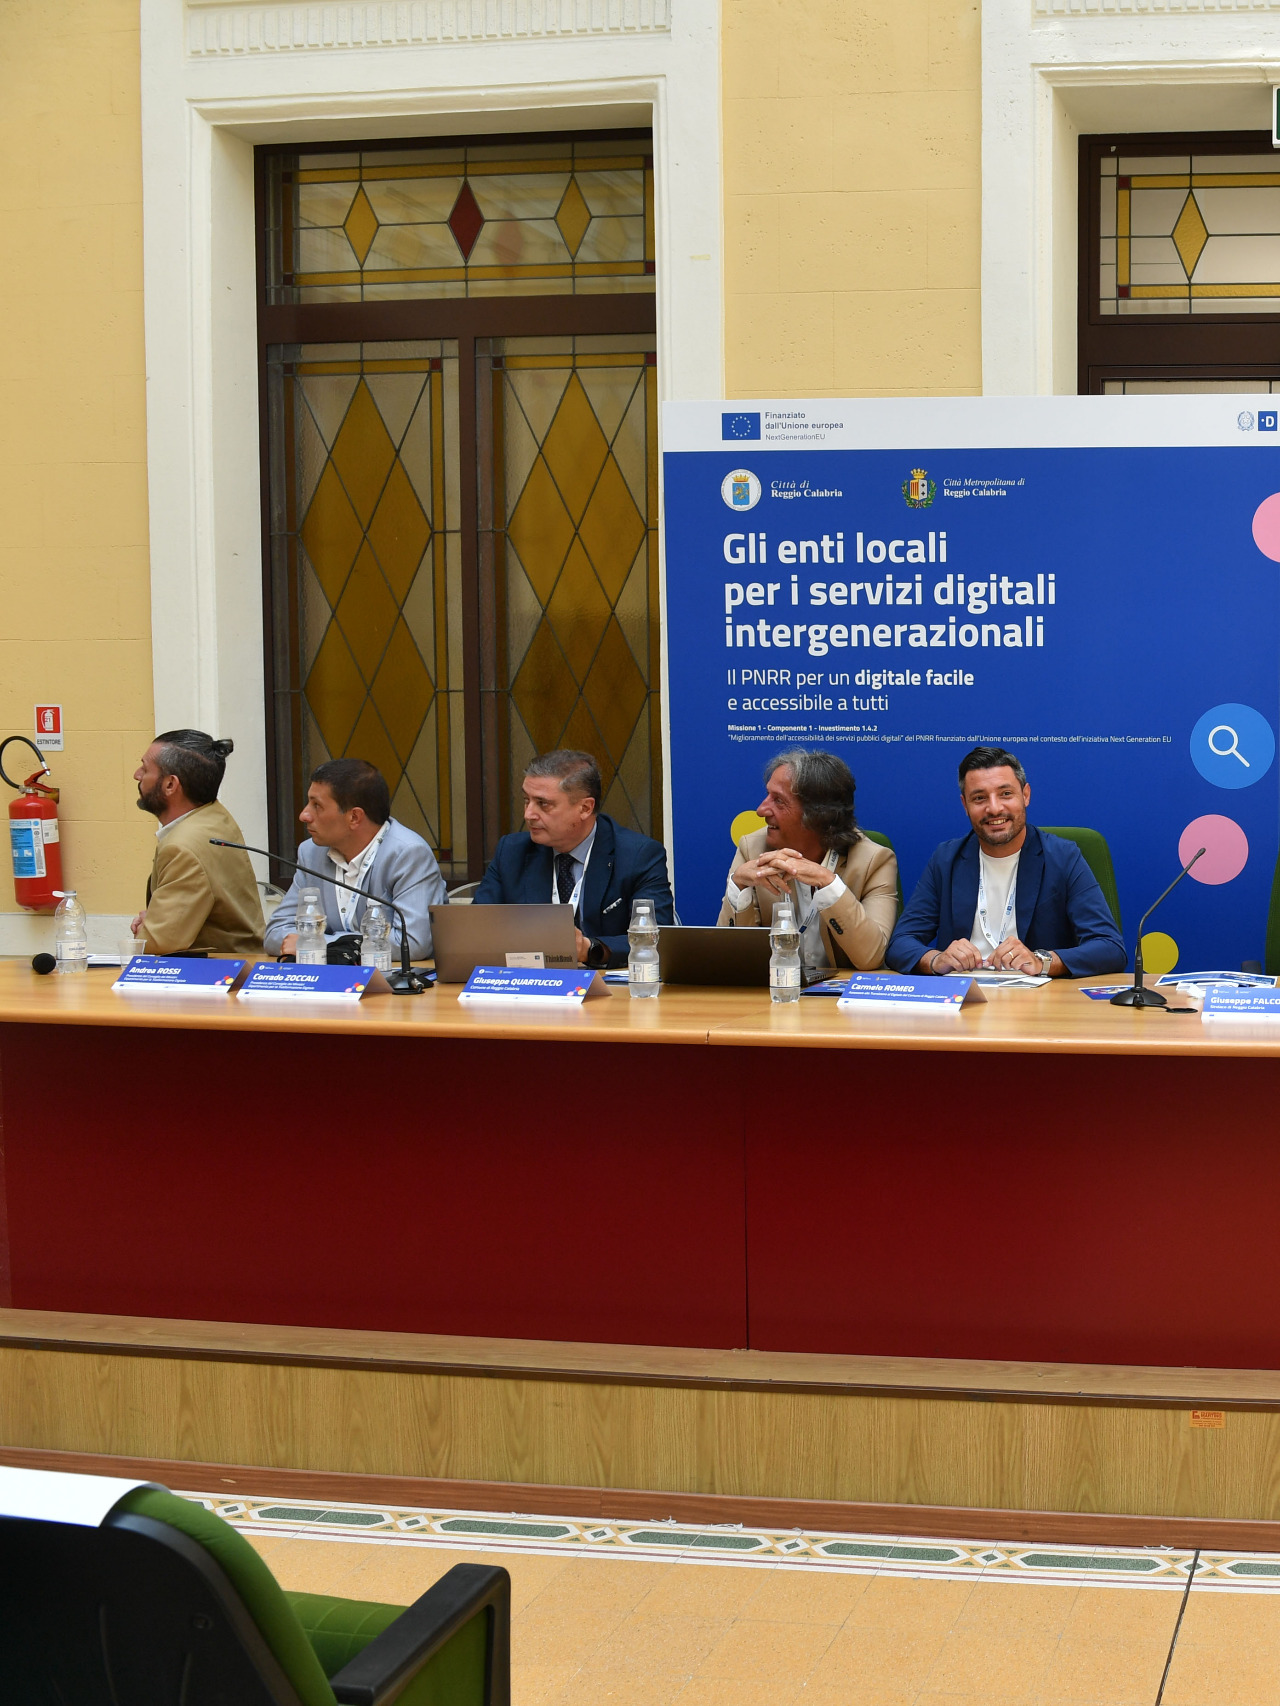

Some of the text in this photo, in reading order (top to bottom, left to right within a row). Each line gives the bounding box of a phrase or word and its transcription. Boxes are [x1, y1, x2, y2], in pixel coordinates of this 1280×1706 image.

[765, 422, 844, 430] dall'Unione europea
[771, 480, 810, 488] Città di
[943, 478, 1026, 488] Città Metropolitana di
[771, 489, 842, 499] Reggio Calabria
[944, 488, 1006, 498] Reggio Calabria
[723, 531, 947, 564] Gli enti locali
[724, 574, 1056, 613] per i servizi digitali
[724, 616, 1045, 656] intergenerazionali
[728, 669, 974, 689] Il PNRR per un digitale facile
[728, 694, 888, 711] e accessibile a tutti
[856, 734, 880, 742] pubblici
[253, 973, 319, 982] Corrado ZOCCALI
[474, 977, 563, 987] Giuseppe QUARTUCCIO
[884, 984, 914, 992] ROMEO
[1210, 997, 1251, 1005] Giuseppe
